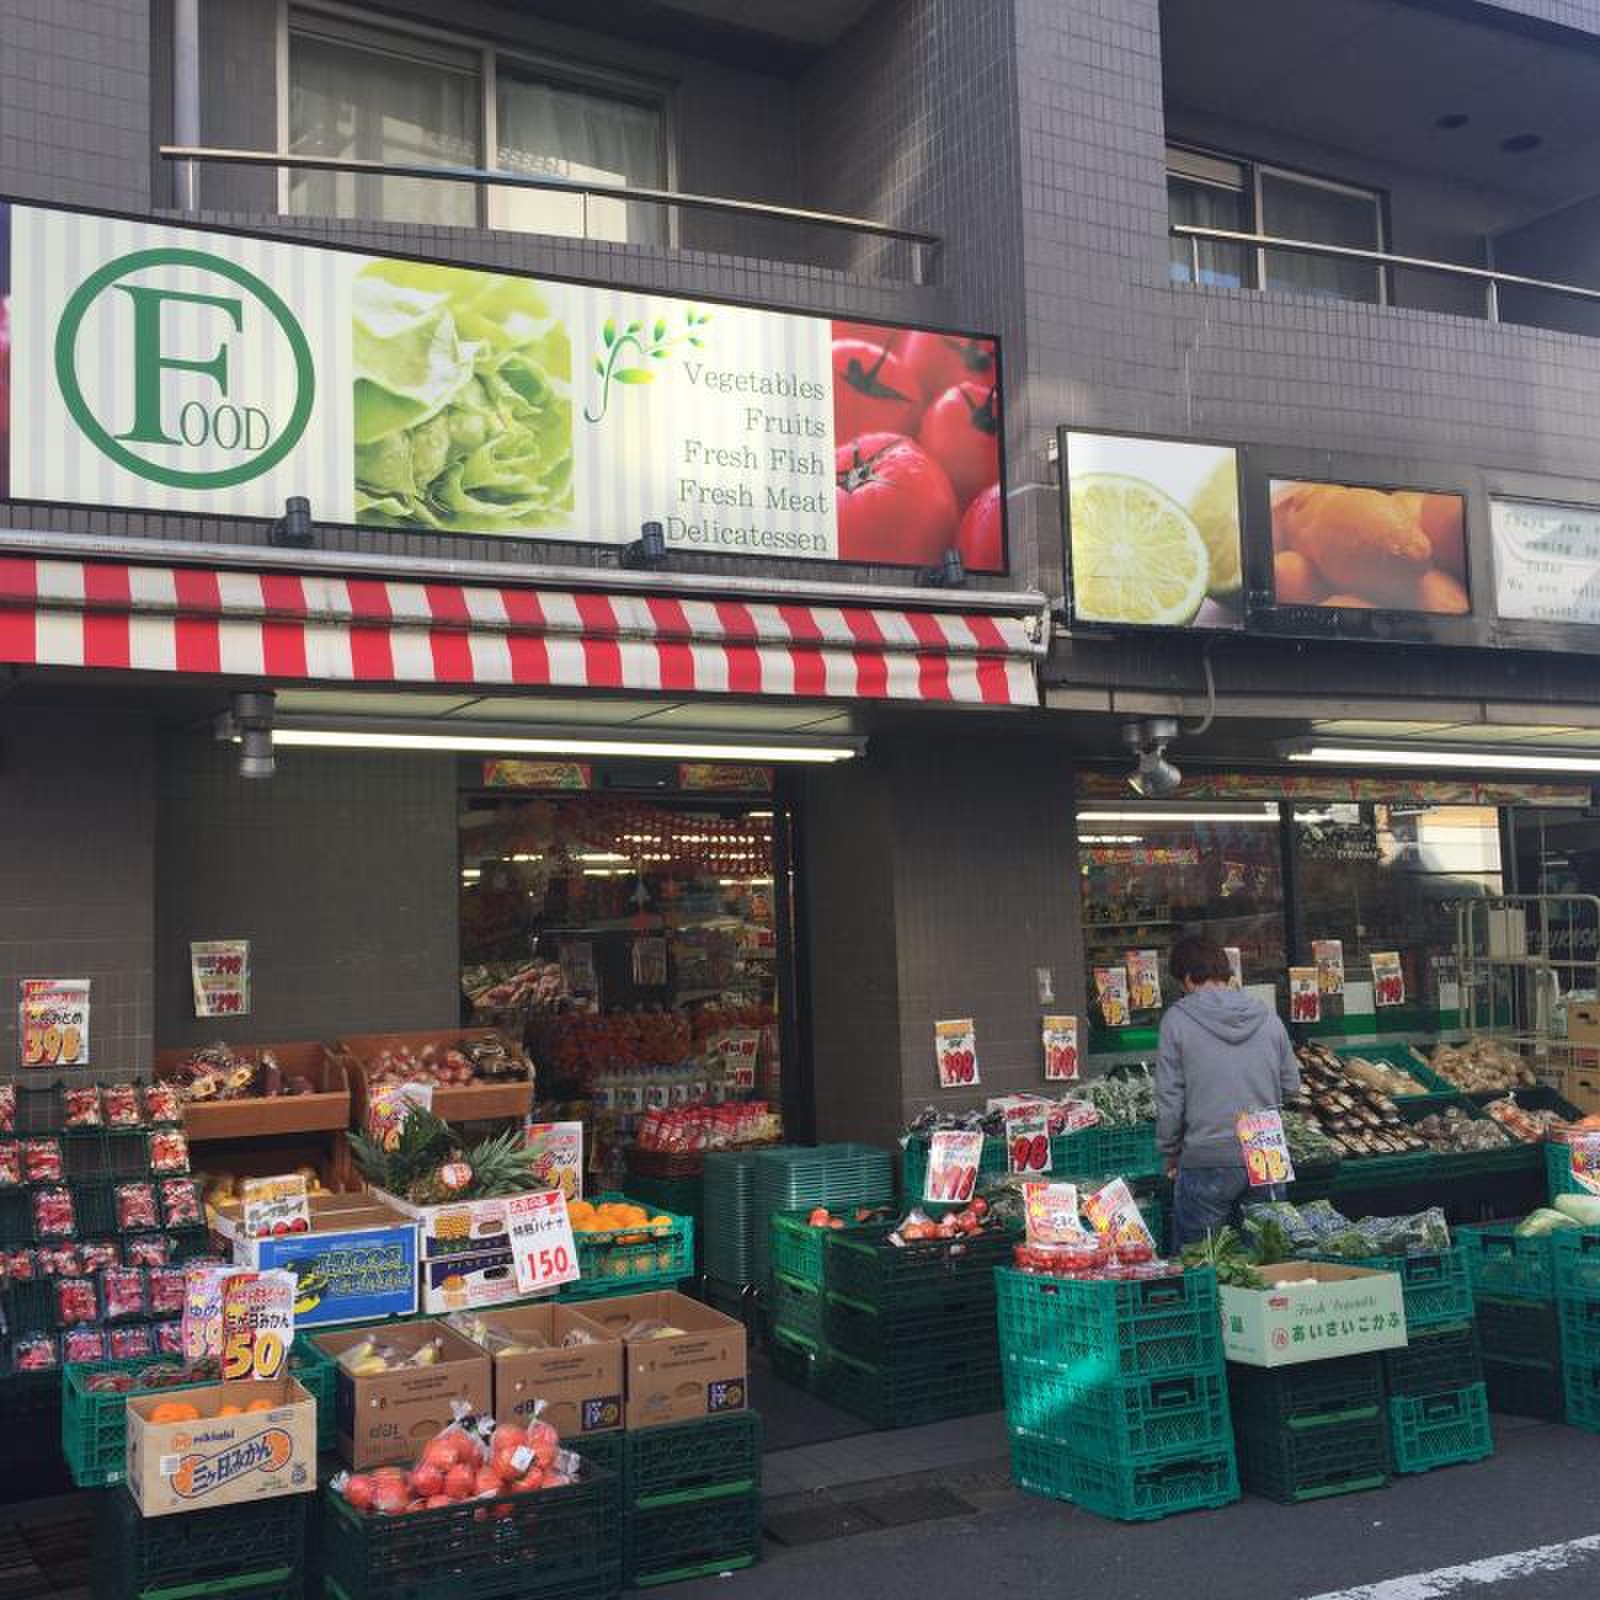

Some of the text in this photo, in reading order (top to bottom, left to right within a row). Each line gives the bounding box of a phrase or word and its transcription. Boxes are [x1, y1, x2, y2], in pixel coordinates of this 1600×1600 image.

[113, 283, 271, 452] FOOD
[682, 361, 825, 400] Vegetables
[744, 407, 826, 438] Fruits
[684, 439, 825, 476] Fresh Fish
[678, 479, 829, 514] Fresh Meat
[666, 517, 827, 551] Delicatessen
[527, 1246, 569, 1281] 150
[223, 1333, 286, 1380] 50
